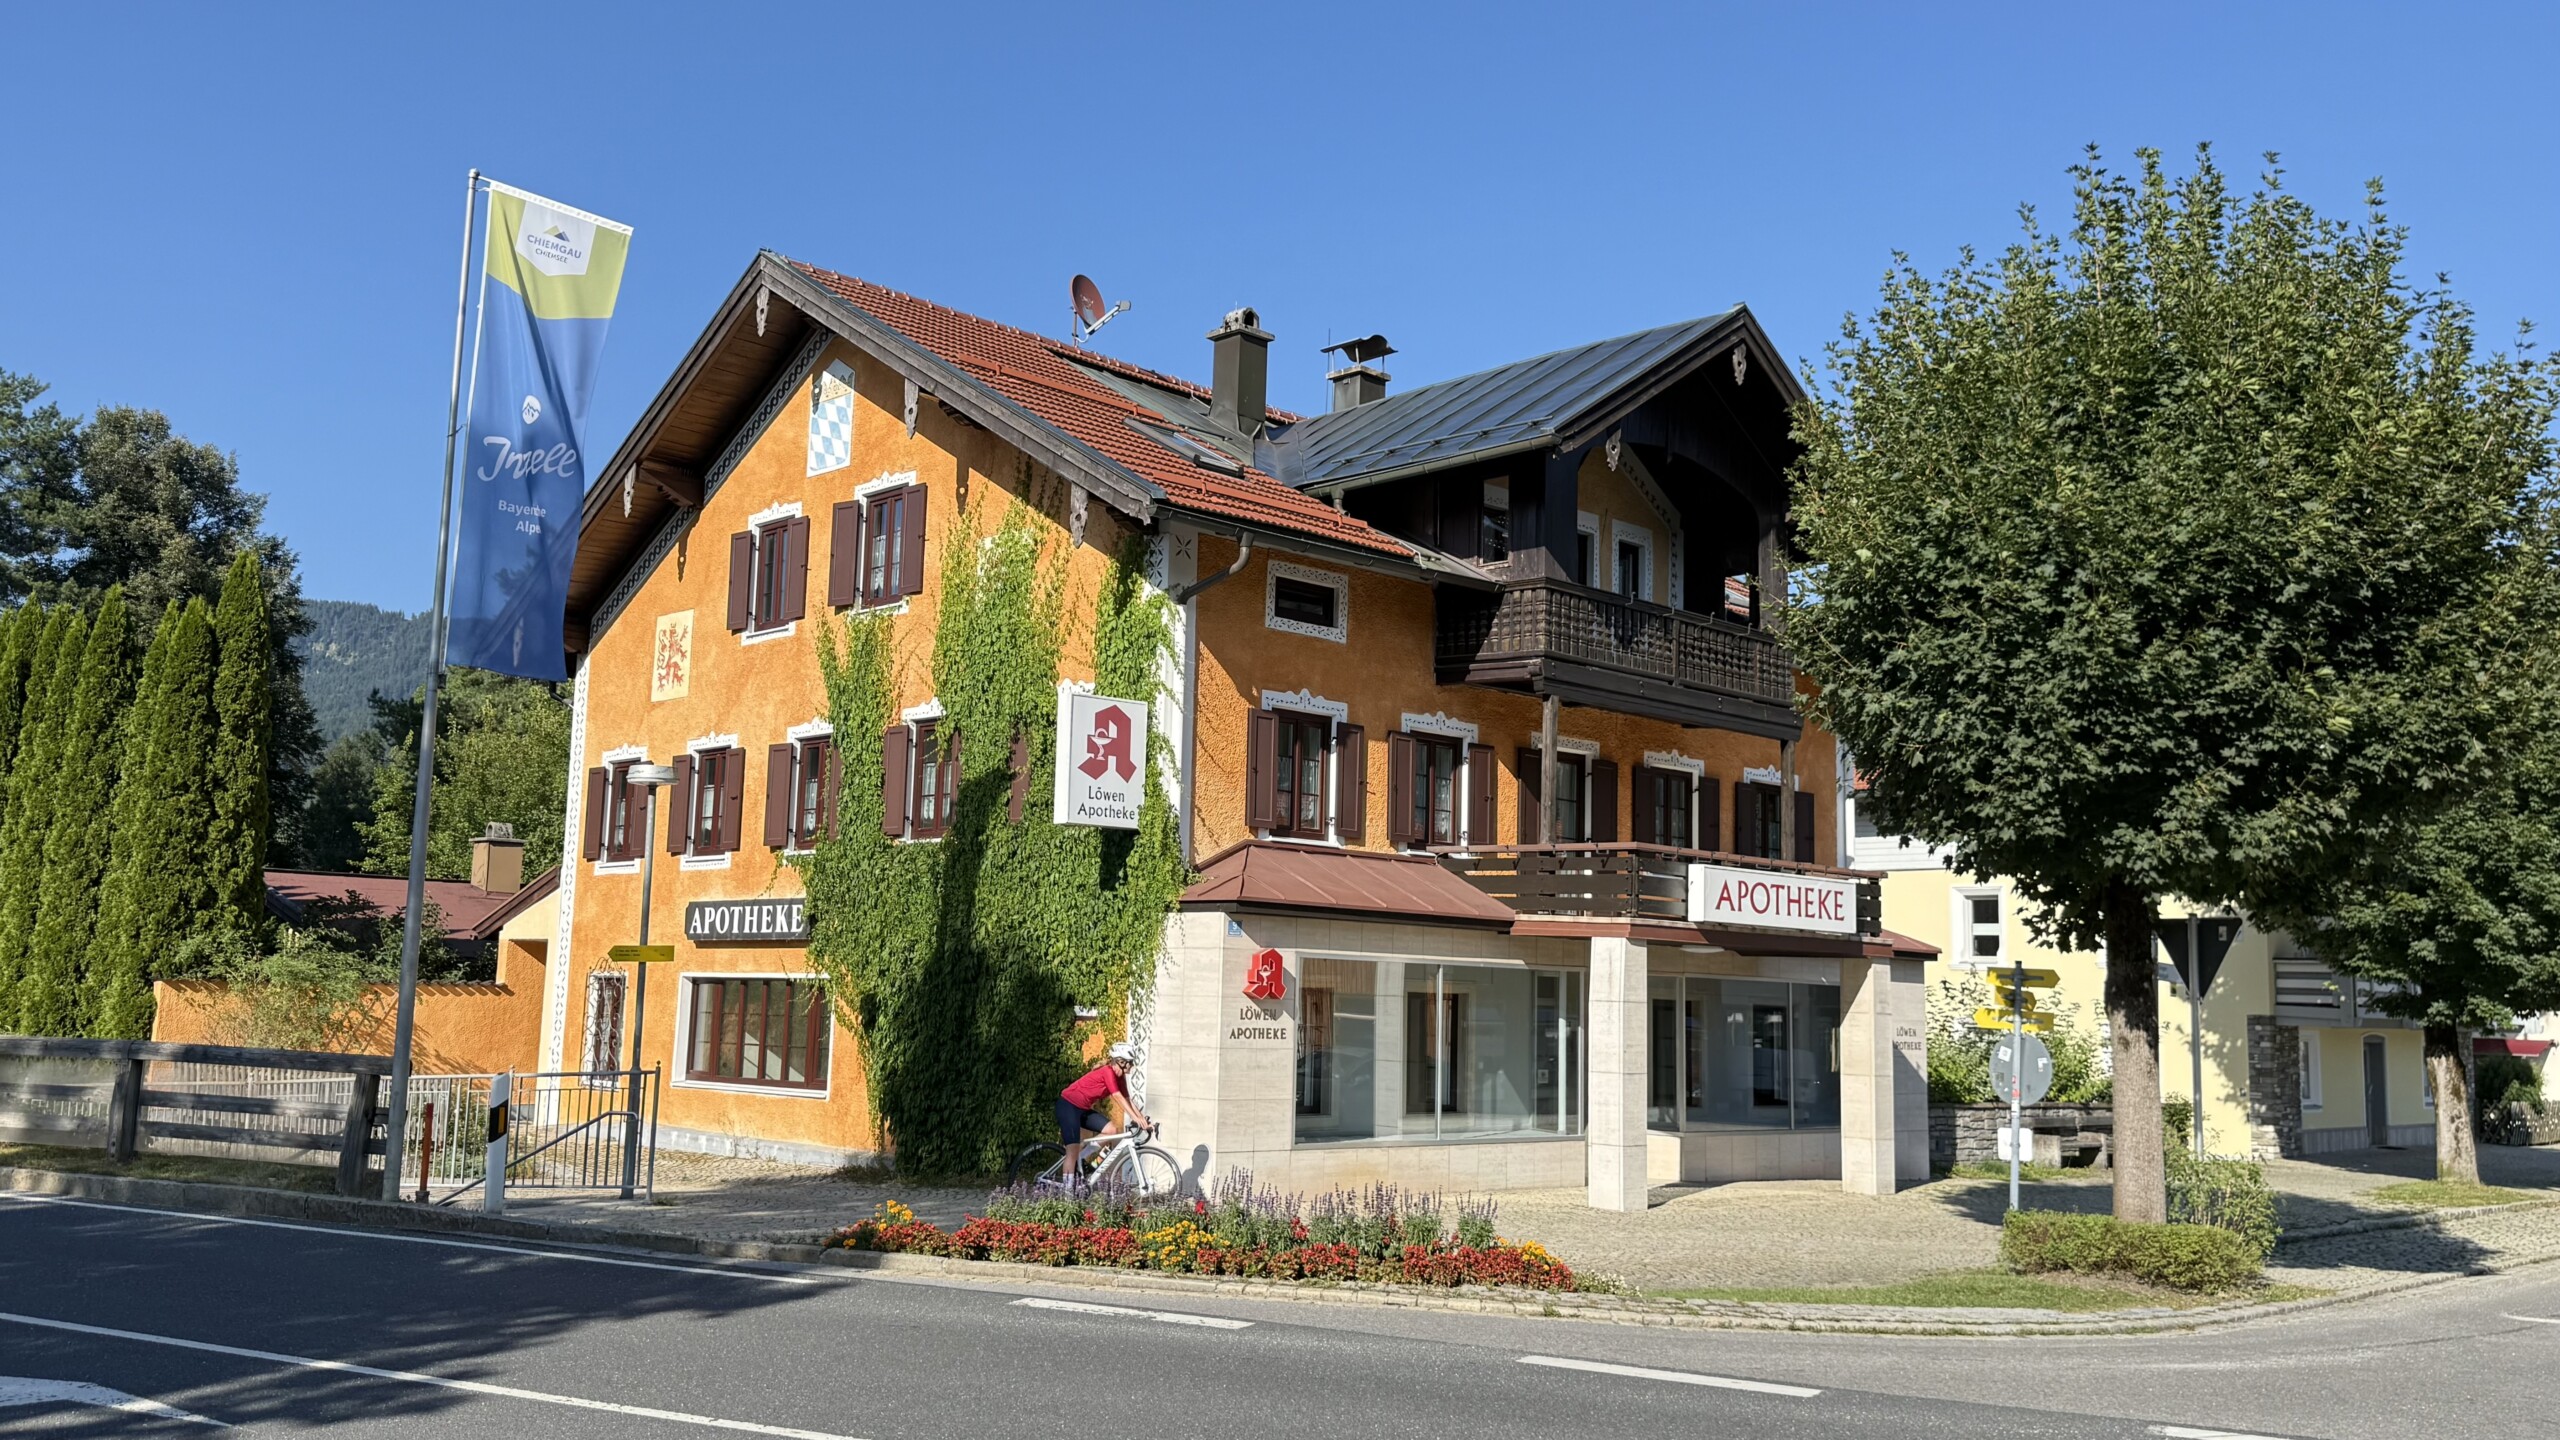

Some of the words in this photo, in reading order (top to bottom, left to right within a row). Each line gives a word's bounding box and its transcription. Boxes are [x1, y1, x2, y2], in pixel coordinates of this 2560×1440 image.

[527, 234, 582, 259] CHIEMGAU
[535, 248, 568, 264] CHIEMSEE
[1088, 785, 1125, 803] Löwen
[1077, 802, 1136, 820] Apotheke
[1715, 879, 1845, 921] APOTHEKE
[689, 904, 804, 934] APOTHEKE
[1240, 1005, 1277, 1021] LÖWEN
[1229, 1027, 1287, 1040] APOTHEKE
